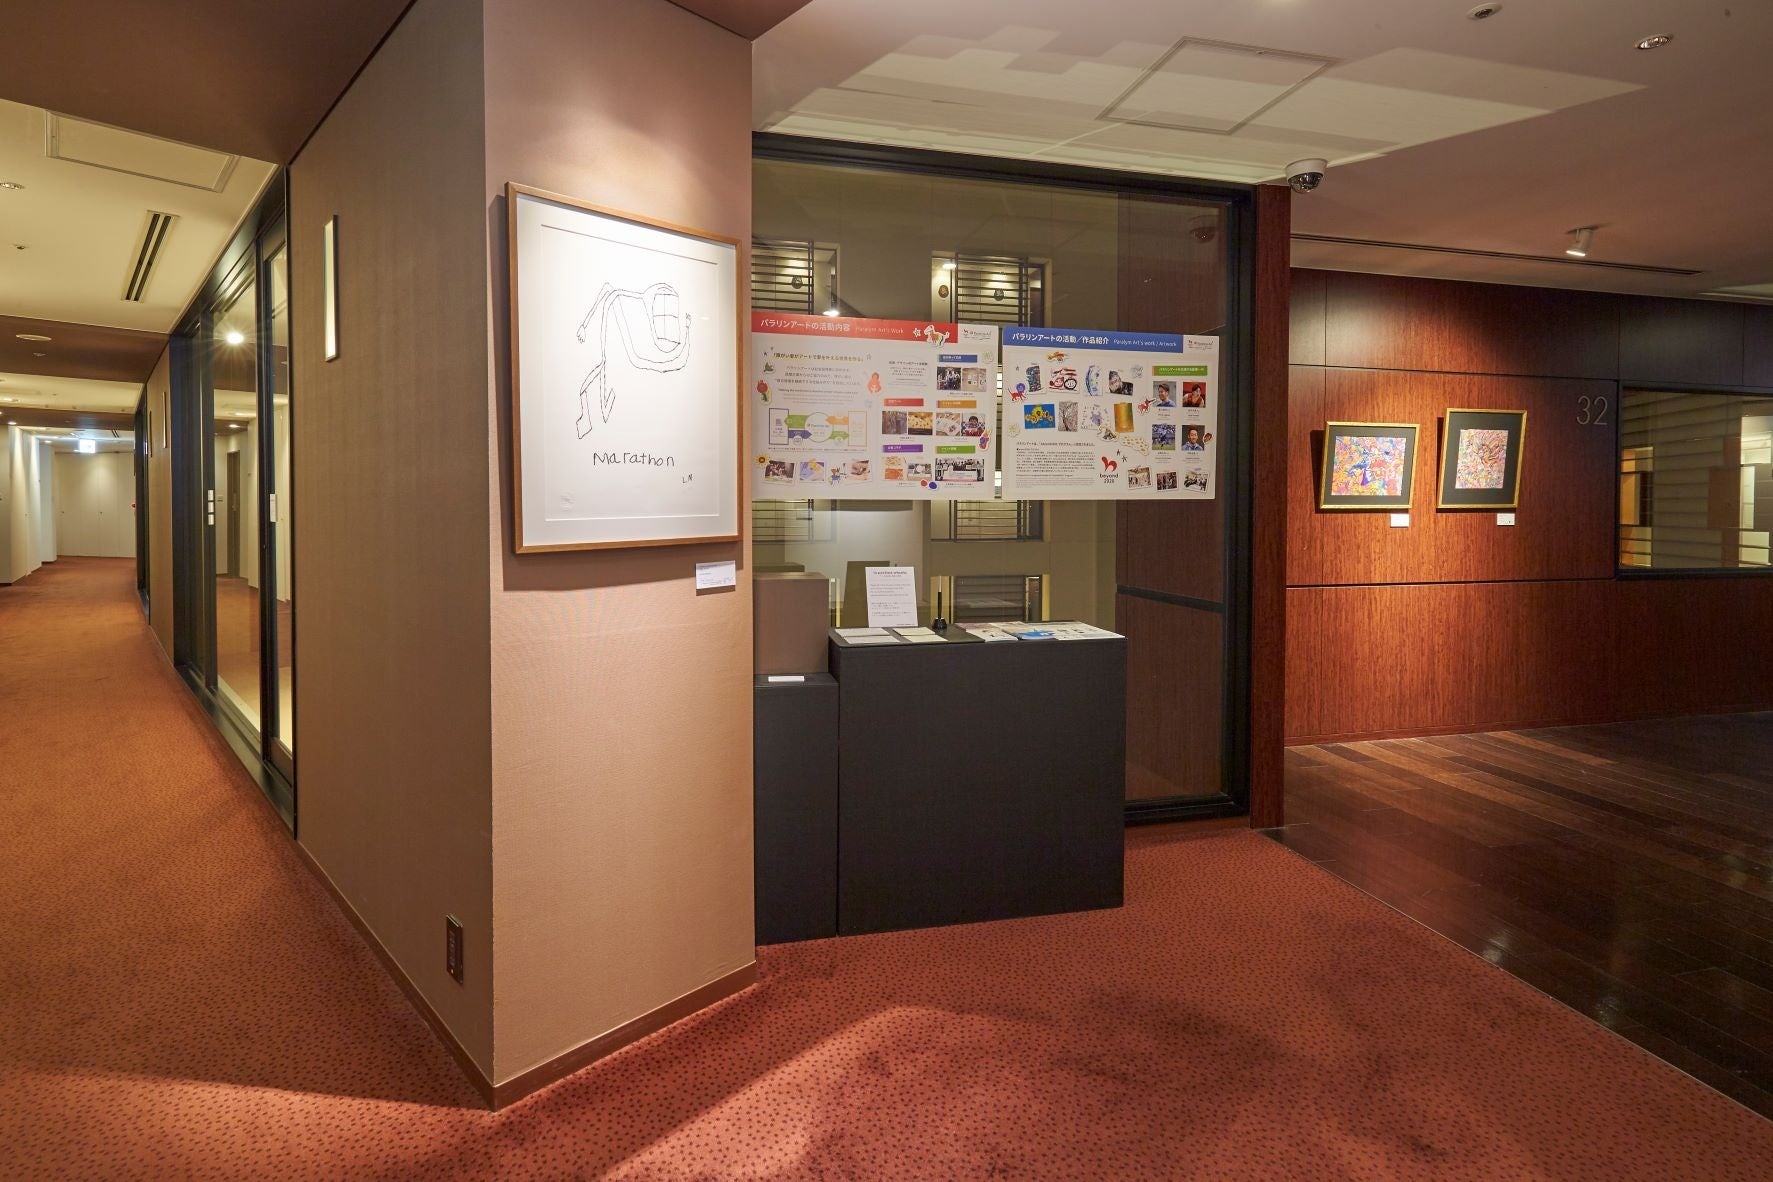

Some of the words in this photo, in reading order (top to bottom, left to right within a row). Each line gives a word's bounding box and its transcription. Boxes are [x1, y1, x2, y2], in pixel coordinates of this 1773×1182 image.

[760, 319, 851, 332] パラリンアートの活動内容
[1576, 395, 1608, 425] 32
[593, 452, 675, 467] Marathon
